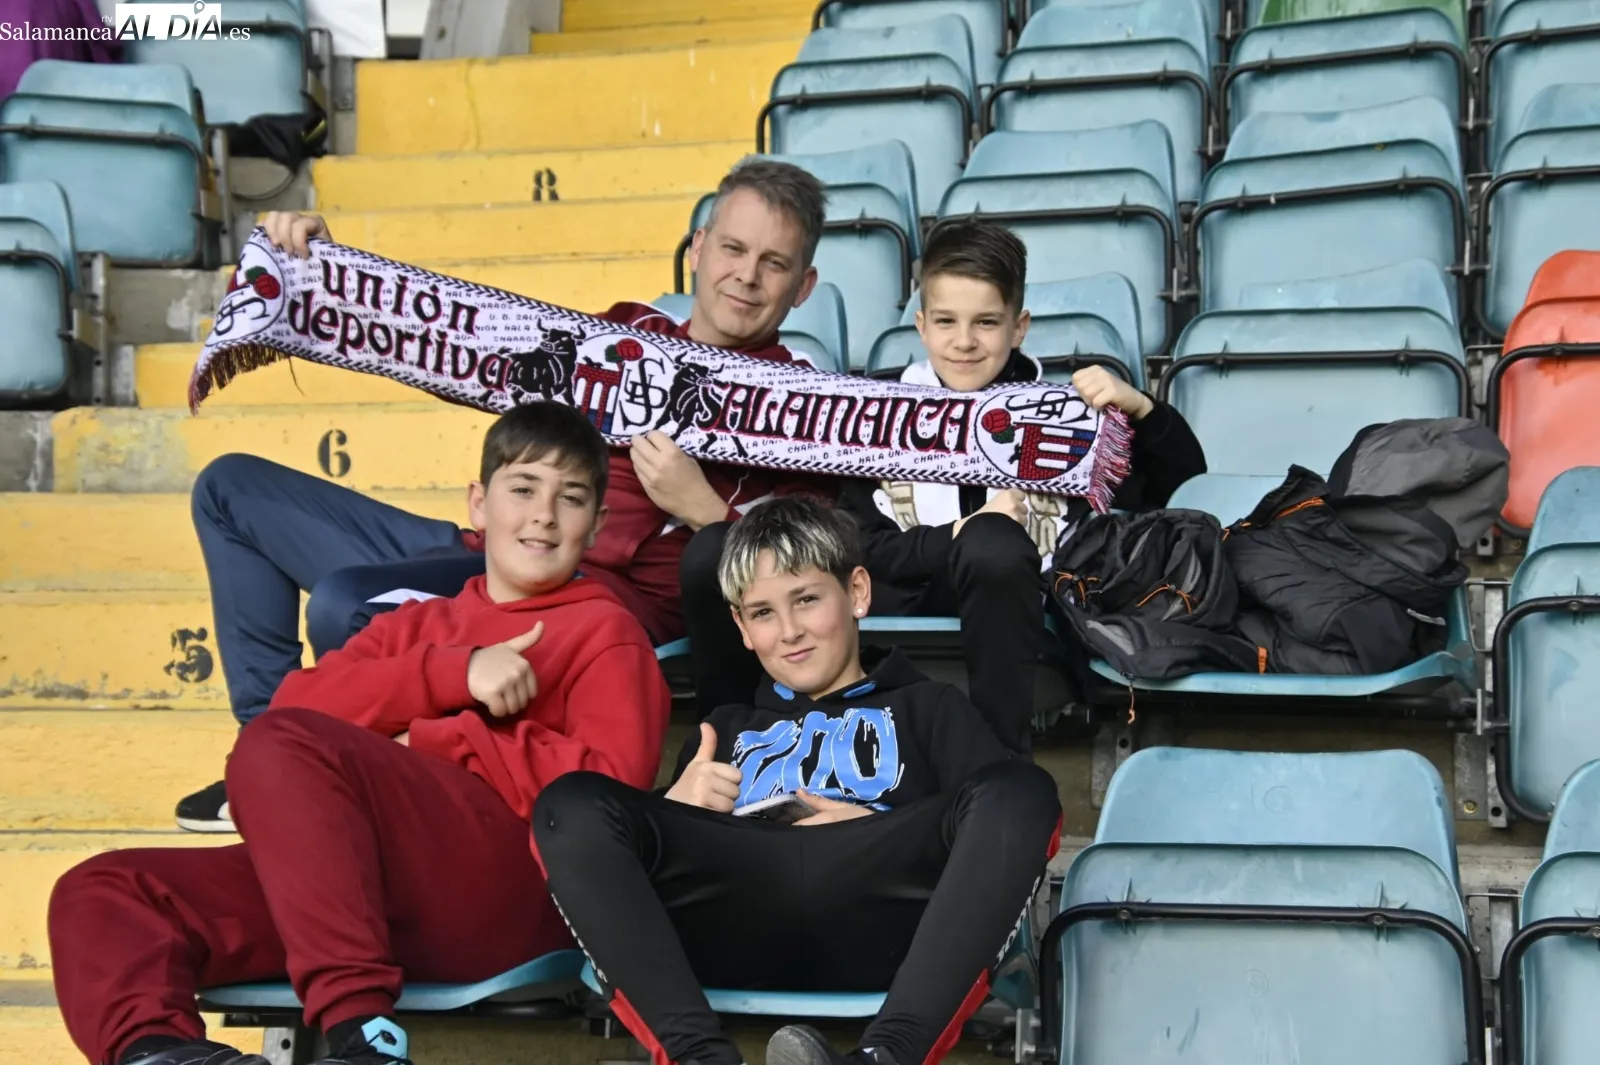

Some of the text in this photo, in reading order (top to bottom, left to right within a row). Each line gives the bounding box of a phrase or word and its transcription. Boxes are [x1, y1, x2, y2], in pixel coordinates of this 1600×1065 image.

[286, 288, 512, 393] deportiva
[318, 430, 351, 477] 6
[694, 380, 977, 455] SALAMANCA
